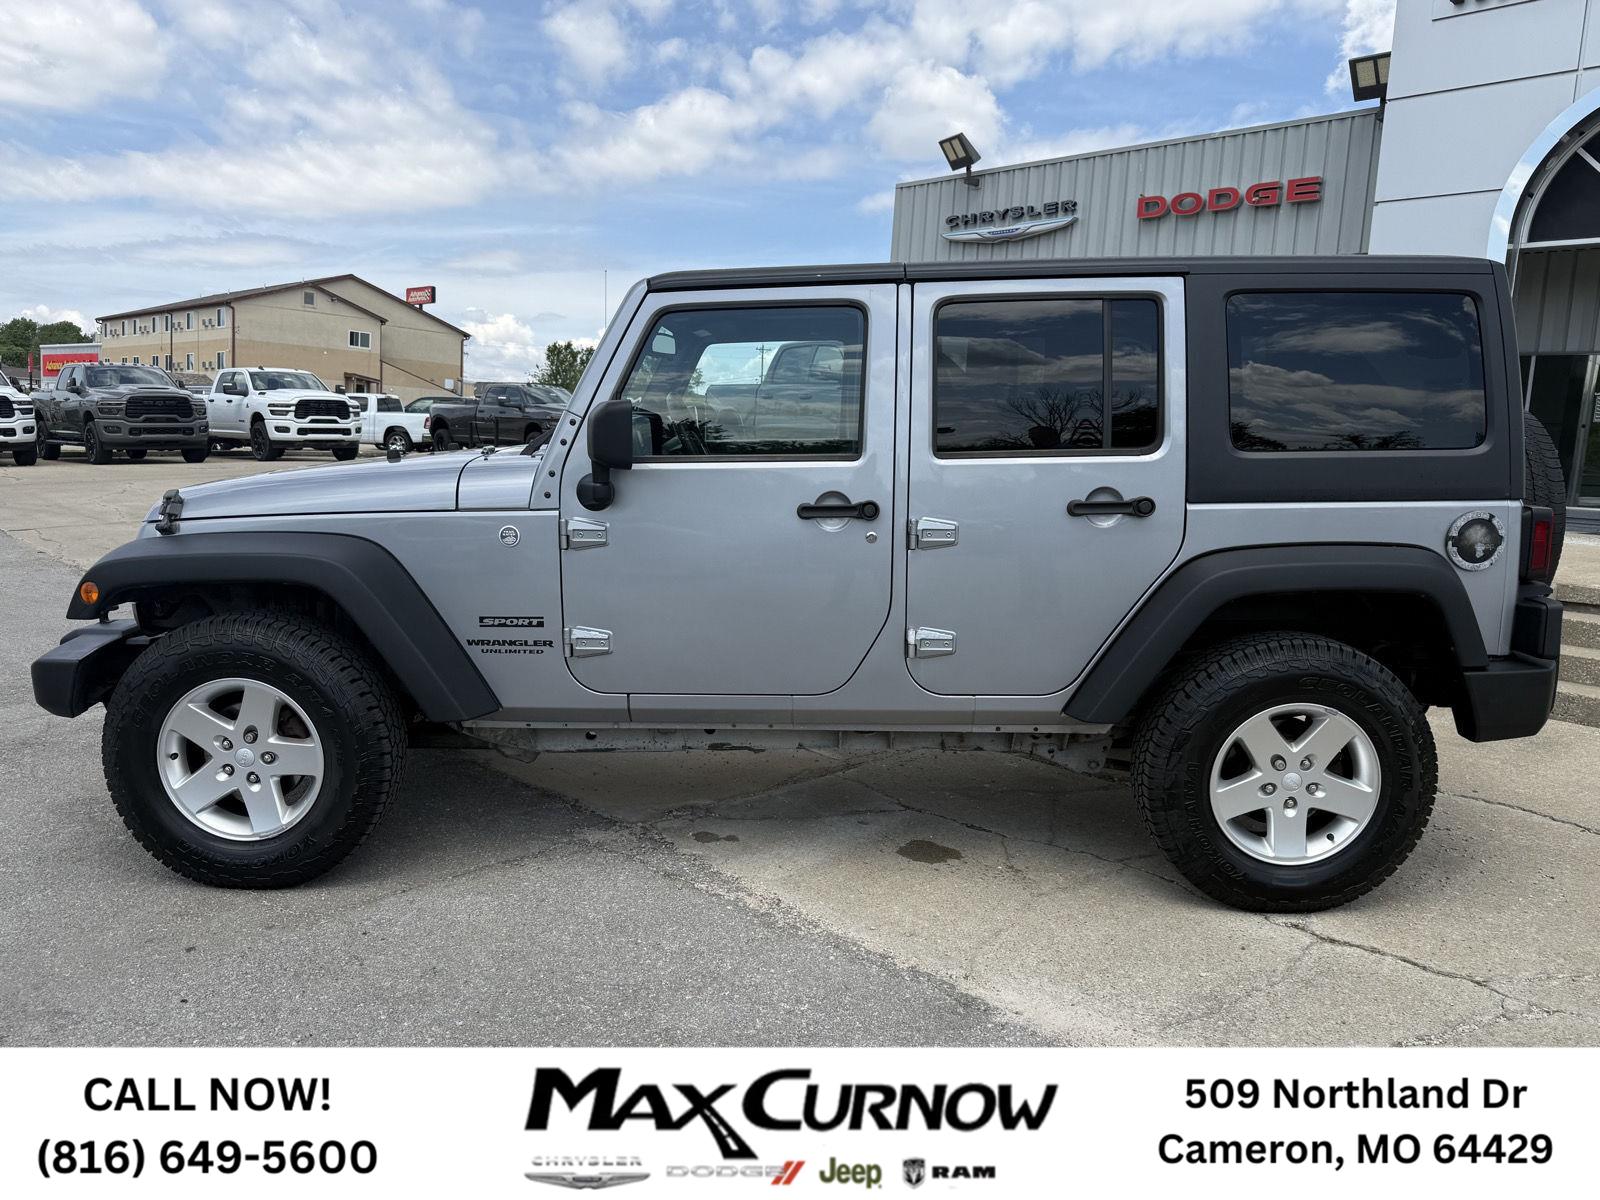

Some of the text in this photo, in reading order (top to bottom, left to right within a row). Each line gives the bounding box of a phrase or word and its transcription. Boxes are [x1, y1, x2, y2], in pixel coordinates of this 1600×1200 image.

[1136, 176, 1324, 220] DODGE
[945, 200, 1078, 228] CHRYSLER
[479, 617, 544, 627] SPORT
[466, 639, 553, 648] WRANGLER
